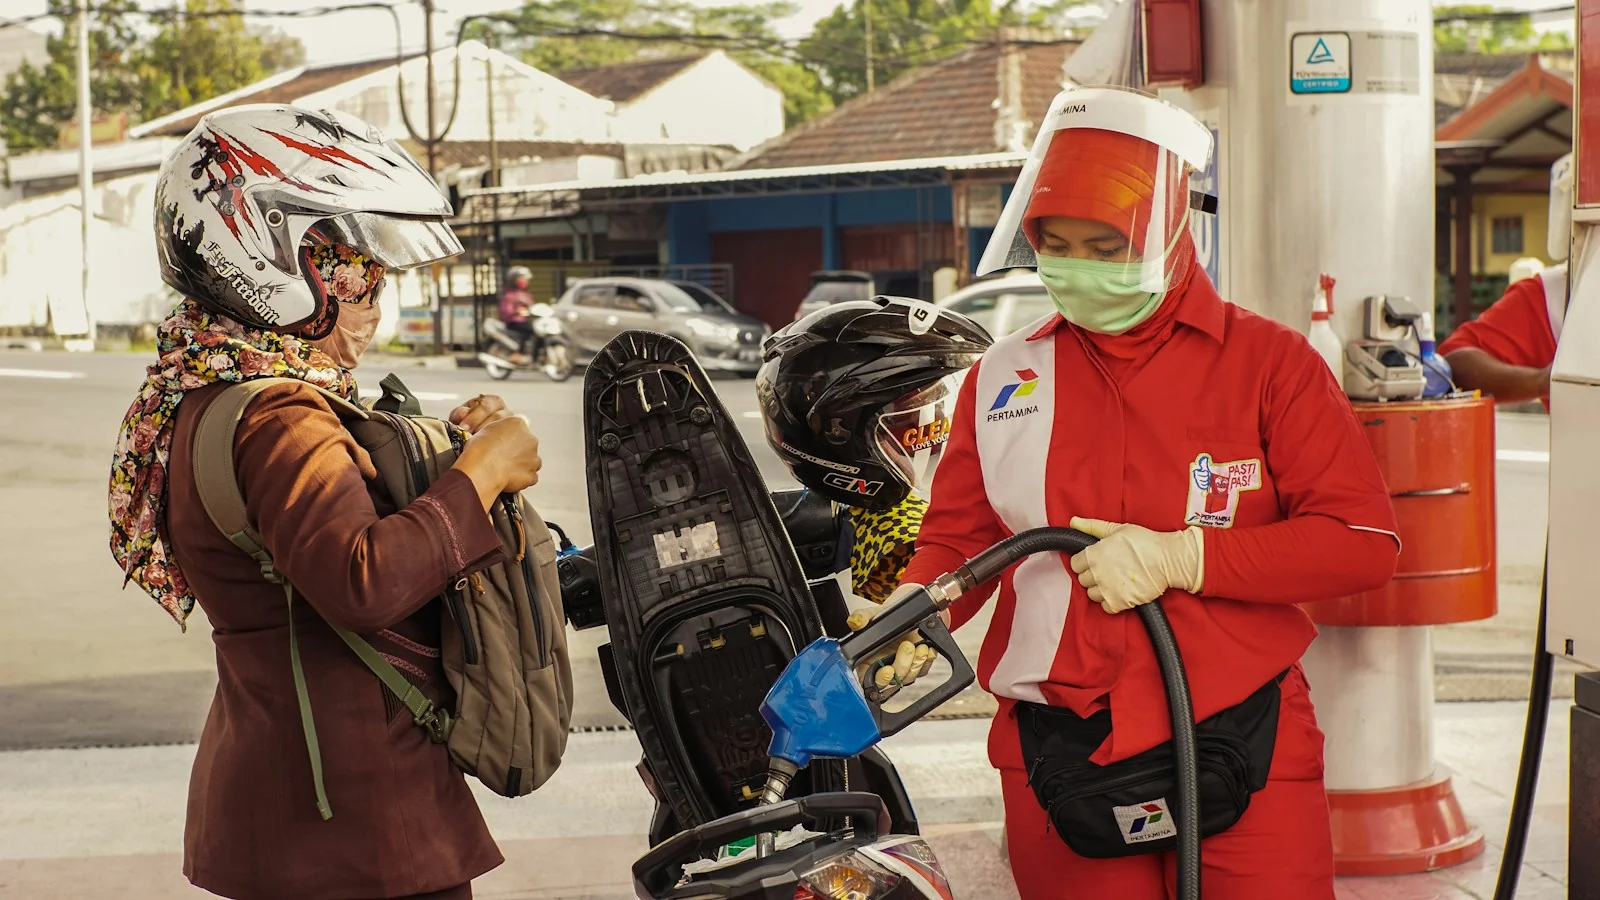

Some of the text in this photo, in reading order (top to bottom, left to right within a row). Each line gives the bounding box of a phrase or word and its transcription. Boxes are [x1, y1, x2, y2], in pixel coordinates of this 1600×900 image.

[1303, 80, 1339, 88] CERTIFIED
[214, 261, 279, 324] Freedom
[987, 405, 1039, 422] PERTAMINA
[911, 439, 932, 451] LOVE
[1228, 463, 1256, 477] PASTI
[823, 472, 884, 497] GM
[1230, 474, 1251, 490] PAS!
